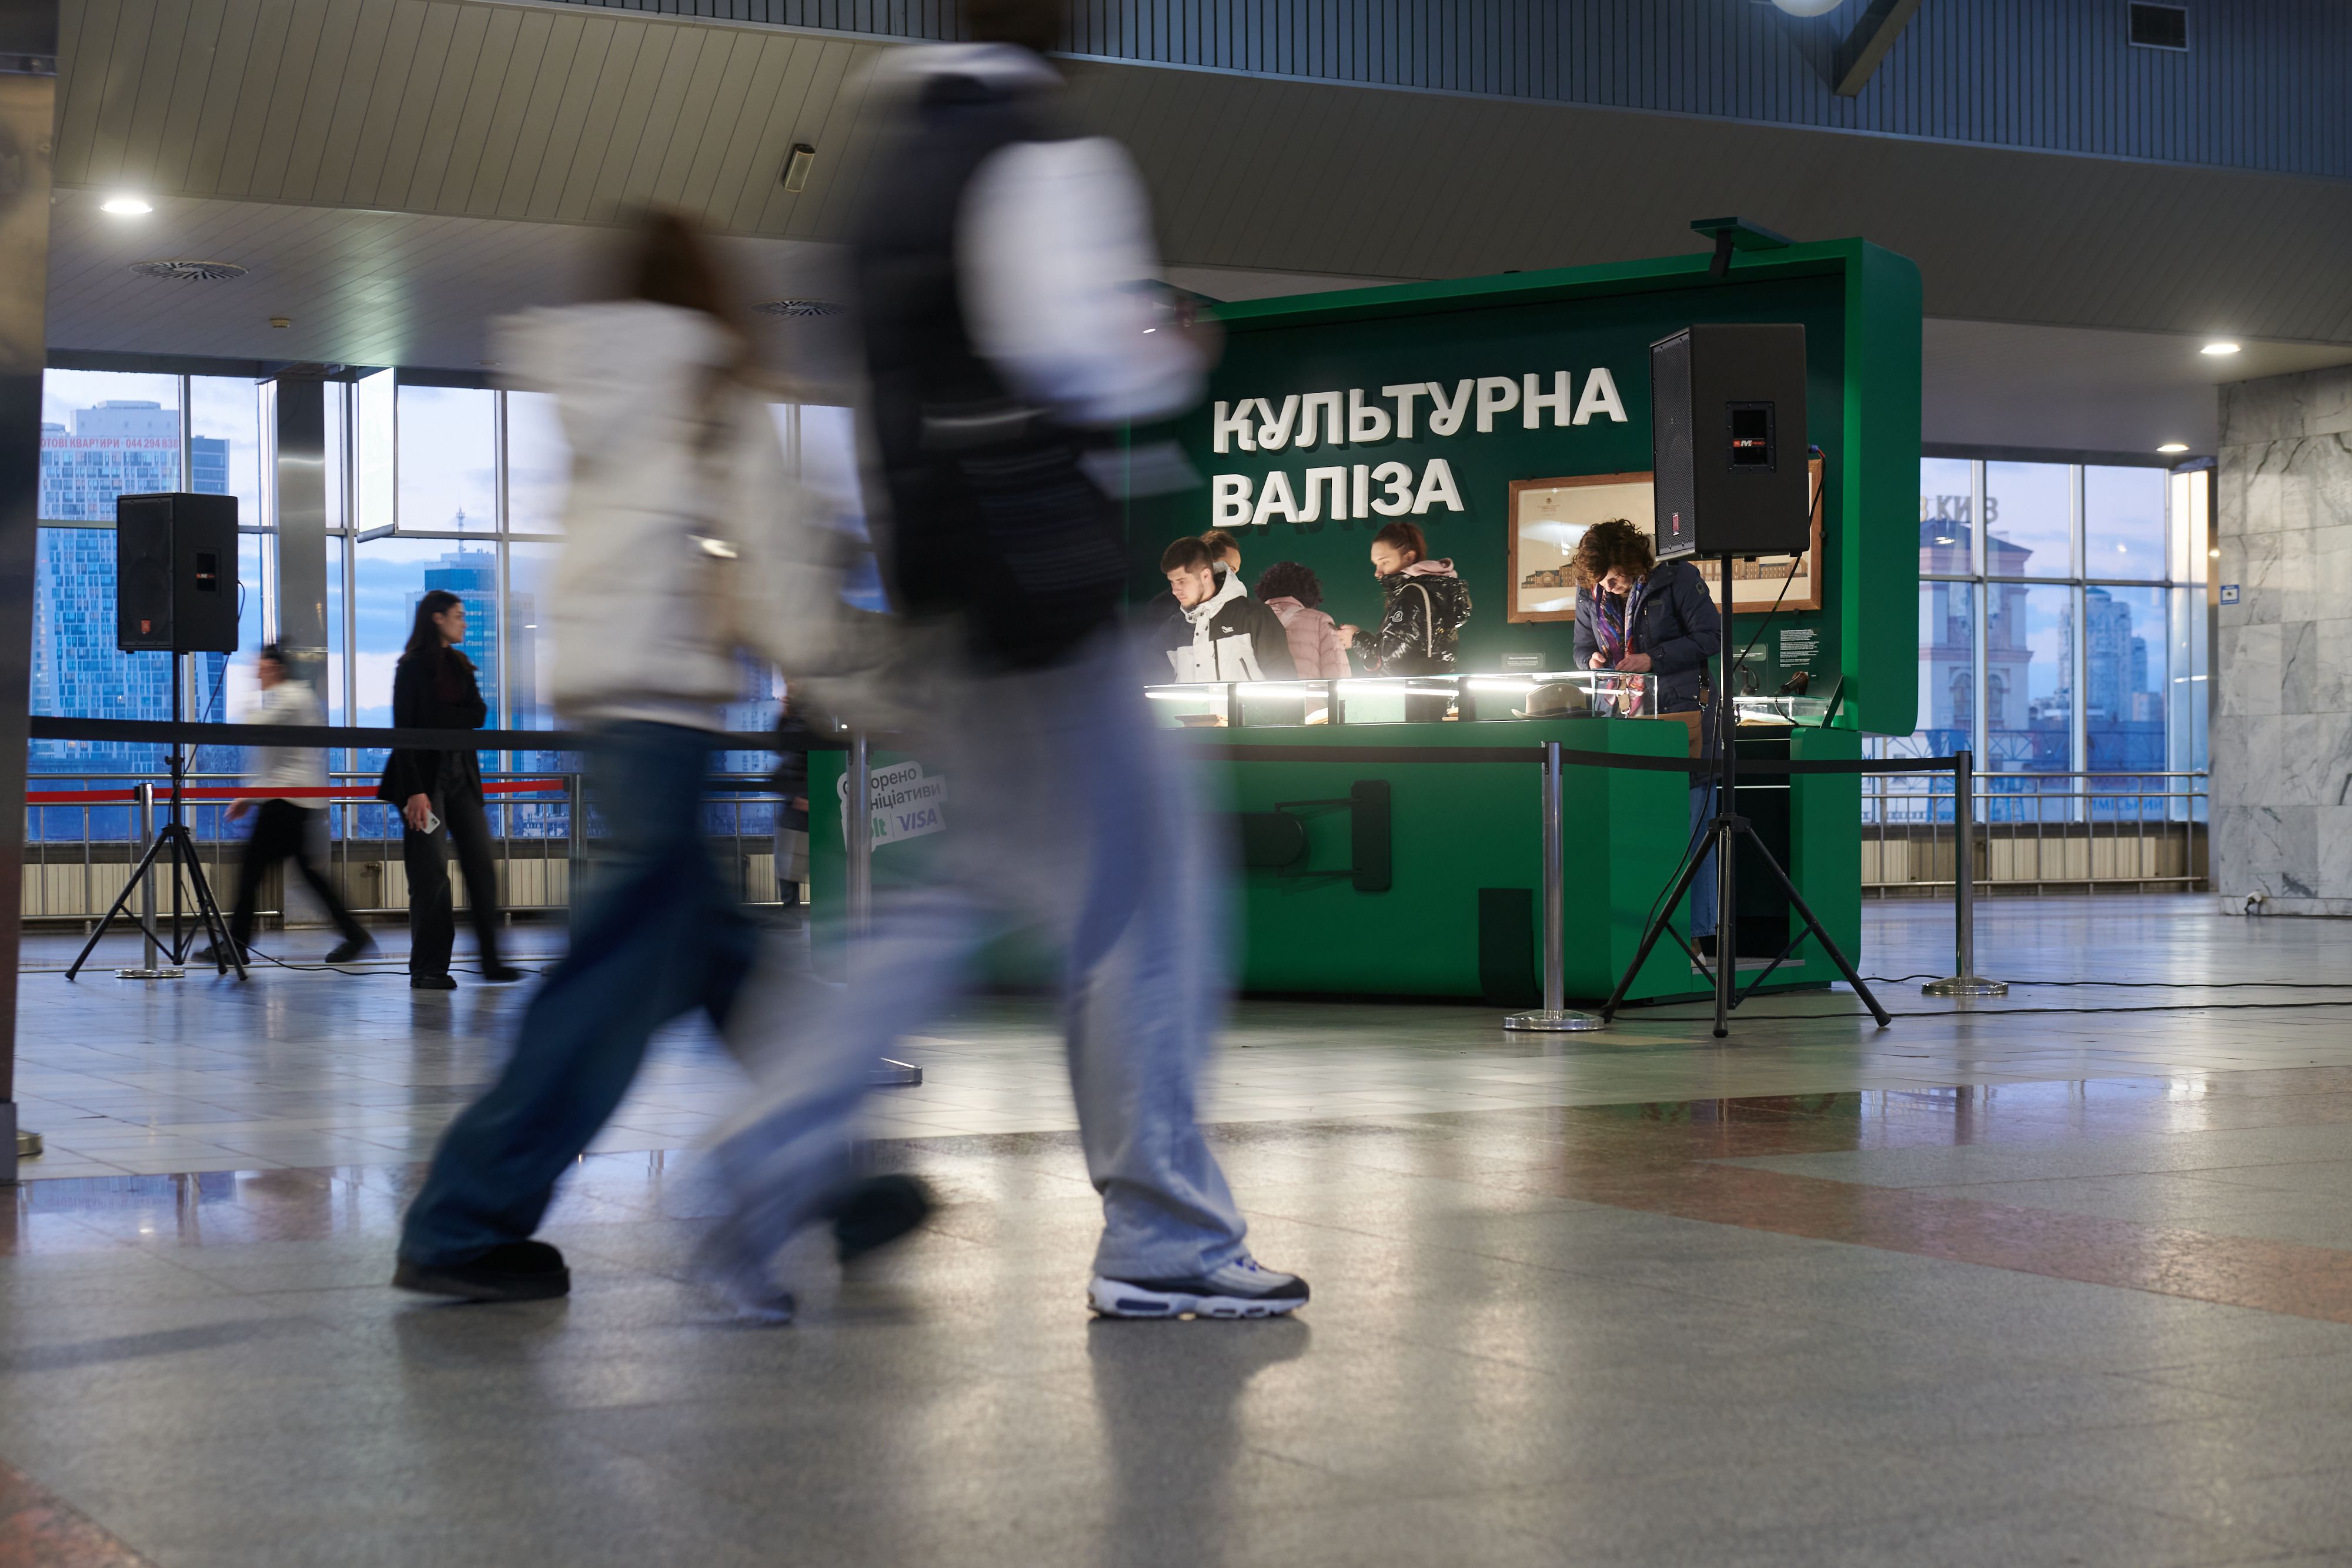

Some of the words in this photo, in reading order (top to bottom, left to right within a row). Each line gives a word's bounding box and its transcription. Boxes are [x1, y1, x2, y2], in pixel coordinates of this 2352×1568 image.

[1213, 367, 1628, 453] КУЛЬТУРНА
[41, 438, 68, 448] ОТОВІ
[126, 438, 142, 448] 044
[144, 438, 160, 448] 294
[162, 438, 178, 448] 838
[1212, 459, 1465, 527] ВАЛІЗА
[1937, 496, 1998, 523] КИВ
[843, 768, 917, 794] орено
[871, 783, 941, 811] ніціативи
[896, 808, 938, 831] VISA
